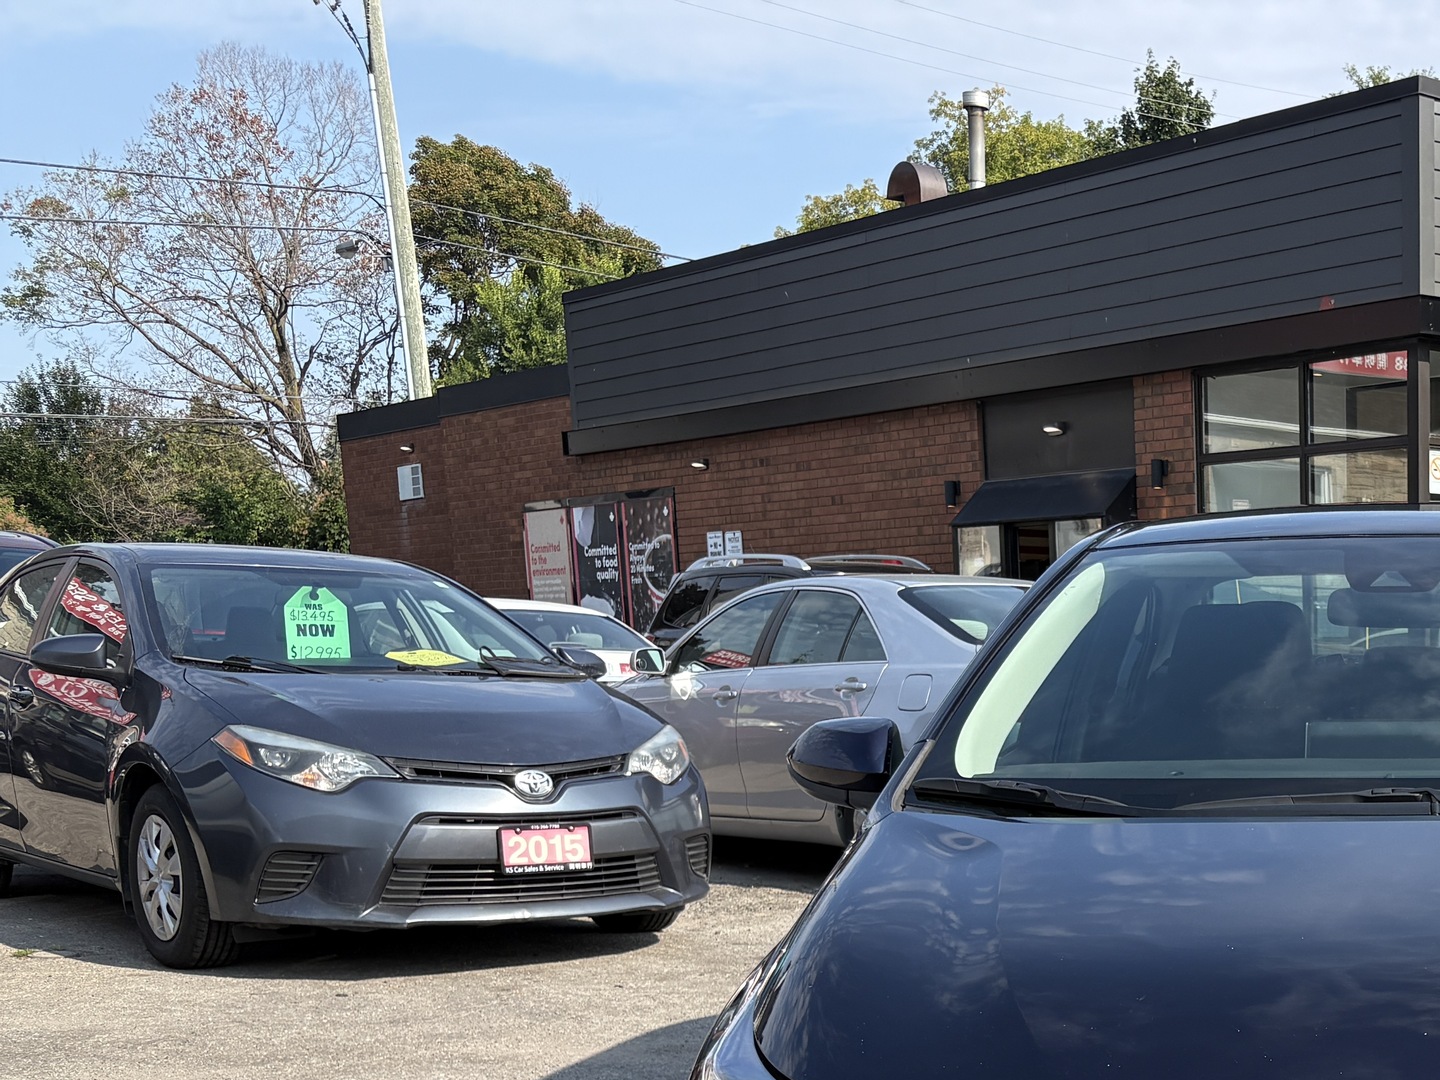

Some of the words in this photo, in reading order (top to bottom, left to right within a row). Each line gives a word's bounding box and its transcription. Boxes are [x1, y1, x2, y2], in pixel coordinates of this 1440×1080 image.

[531, 542, 561, 554] Committed
[584, 543, 618, 557] Committed
[531, 556, 538, 566] to
[538, 554, 548, 566] the
[595, 558, 602, 568] to
[602, 556, 618, 568] food
[532, 565, 567, 577] environment
[596, 568, 619, 583] quality
[304, 603, 323, 611] WAS
[296, 624, 336, 638] NOW
[508, 834, 584, 864] 2015
